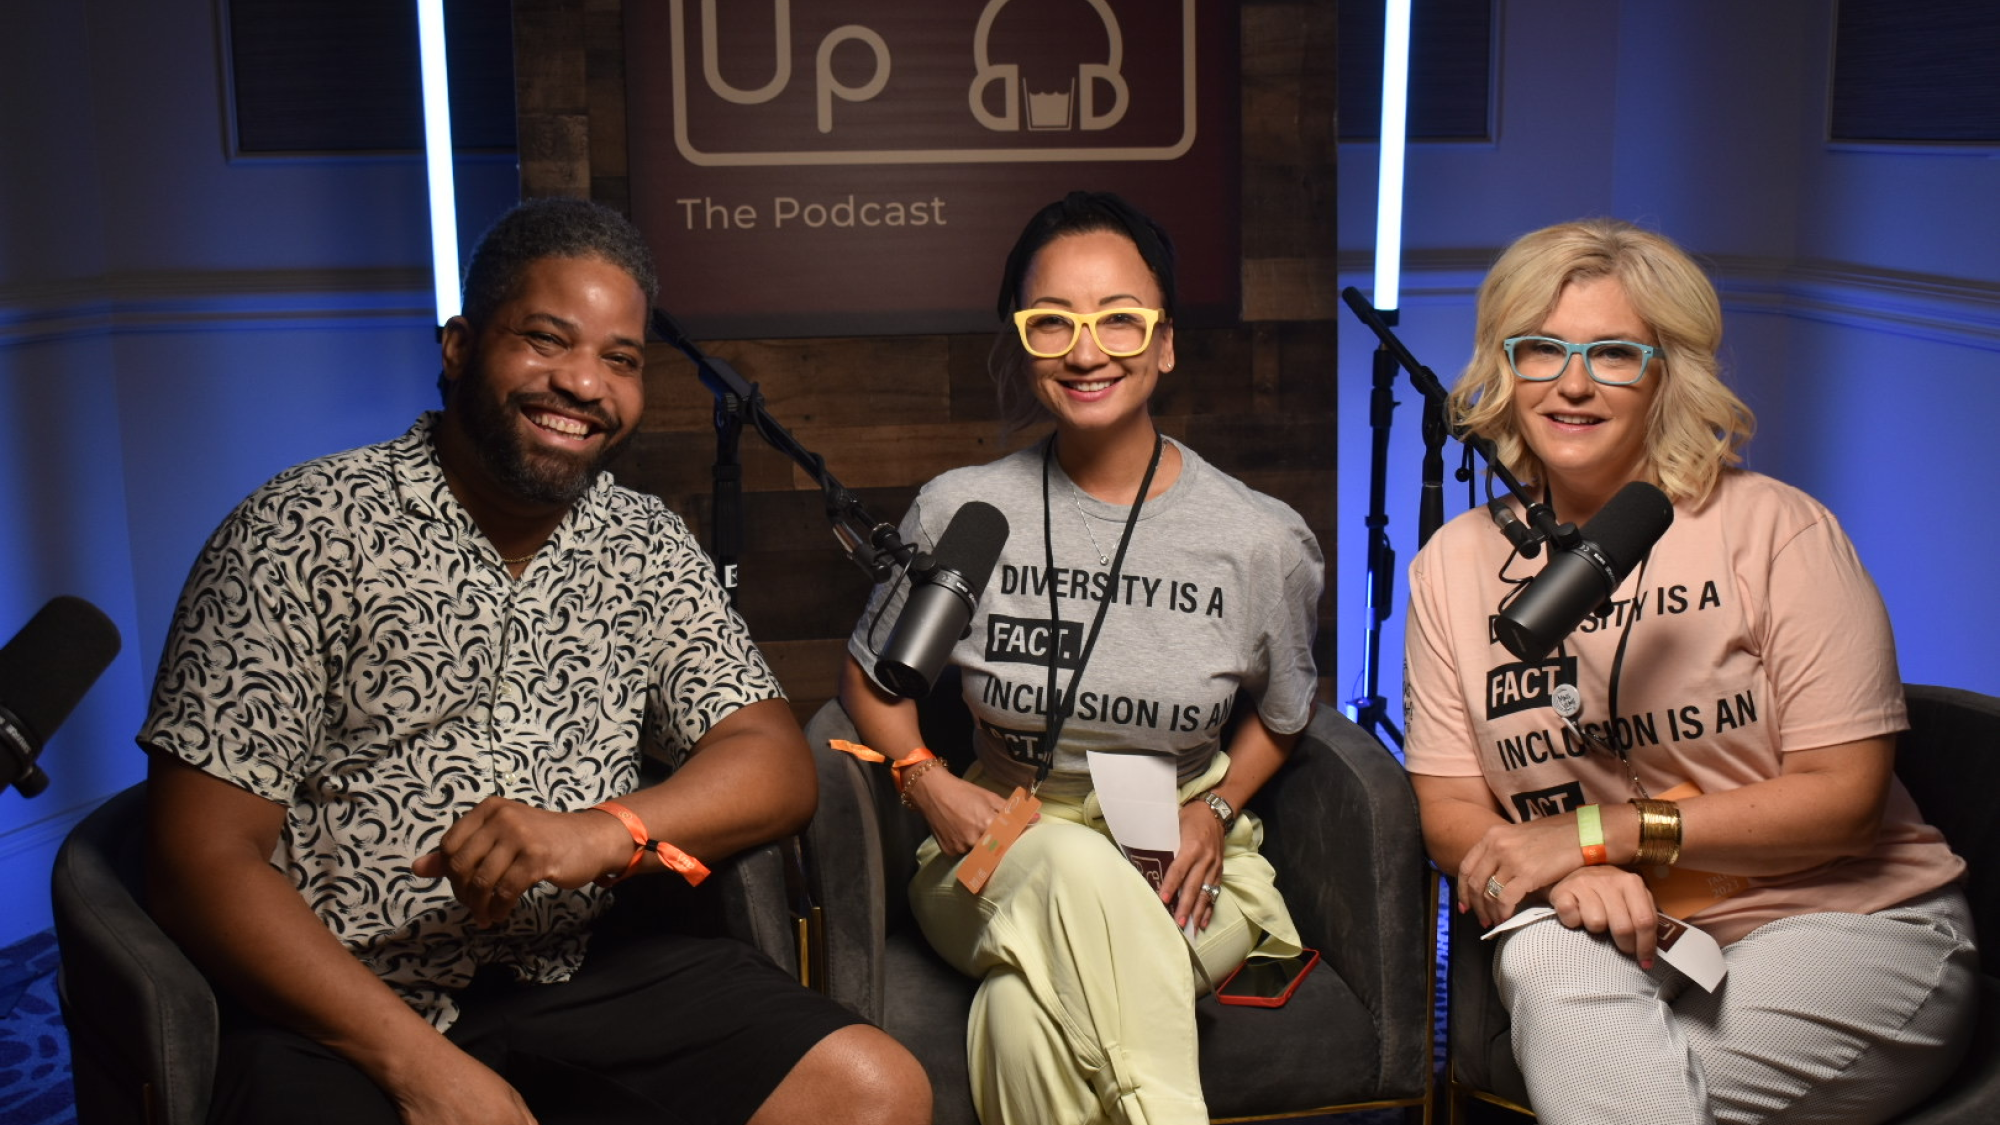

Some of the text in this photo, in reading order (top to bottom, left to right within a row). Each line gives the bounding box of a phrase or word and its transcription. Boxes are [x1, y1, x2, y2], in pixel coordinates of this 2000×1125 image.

[702, 0, 891, 134] Up
[676, 194, 948, 230] The Podcast
[1169, 580, 1198, 614] IS
[1205, 586, 1224, 619] A
[1656, 584, 1689, 616] IS
[1698, 580, 1721, 611] A
[1169, 703, 1200, 732] IS
[1667, 705, 1704, 742] IS
[1715, 689, 1758, 734] AN
